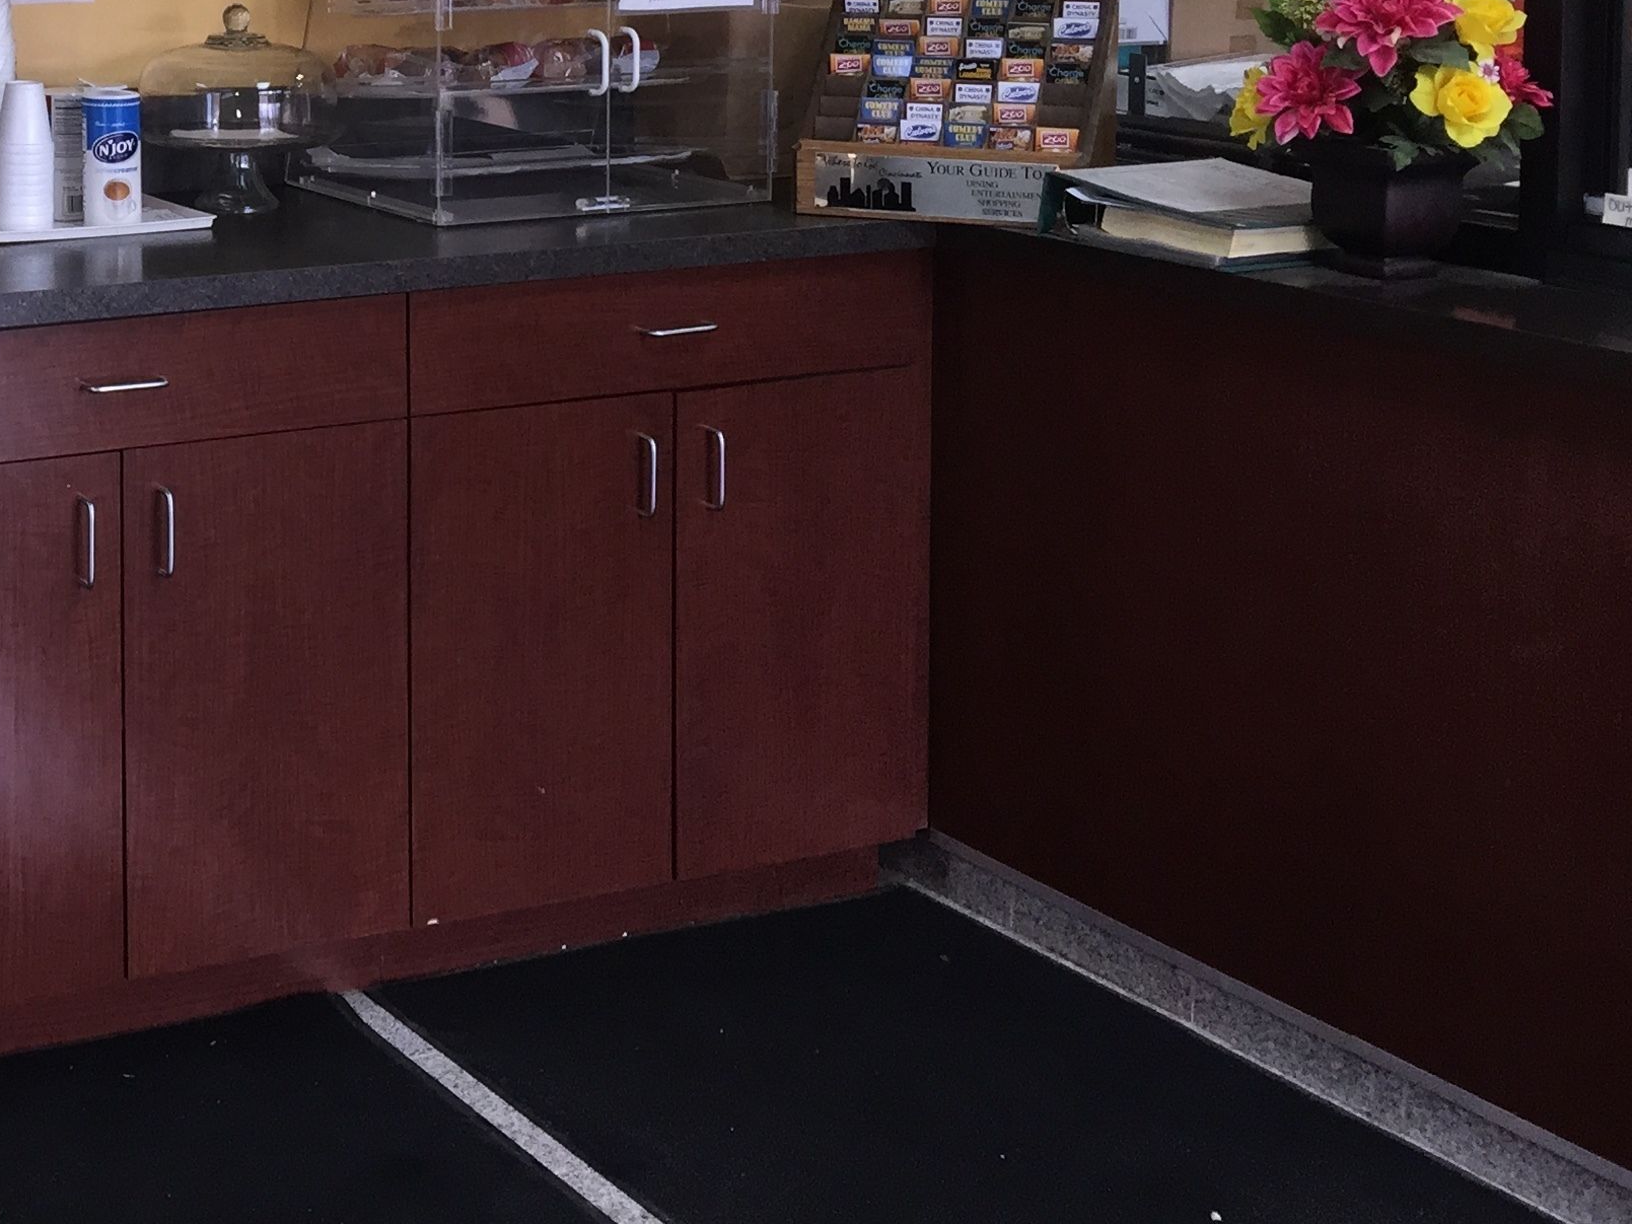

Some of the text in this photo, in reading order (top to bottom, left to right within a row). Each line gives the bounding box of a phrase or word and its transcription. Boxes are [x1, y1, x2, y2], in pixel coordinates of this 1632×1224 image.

[927, 161, 965, 176] YOUR
[969, 163, 1018, 179] GUIDE
[966, 180, 999, 189] DINING
[971, 189, 1041, 200] ENTERTAINMEN
[977, 199, 1022, 209] SHOPPING
[982, 208, 1024, 217] SERVICES
